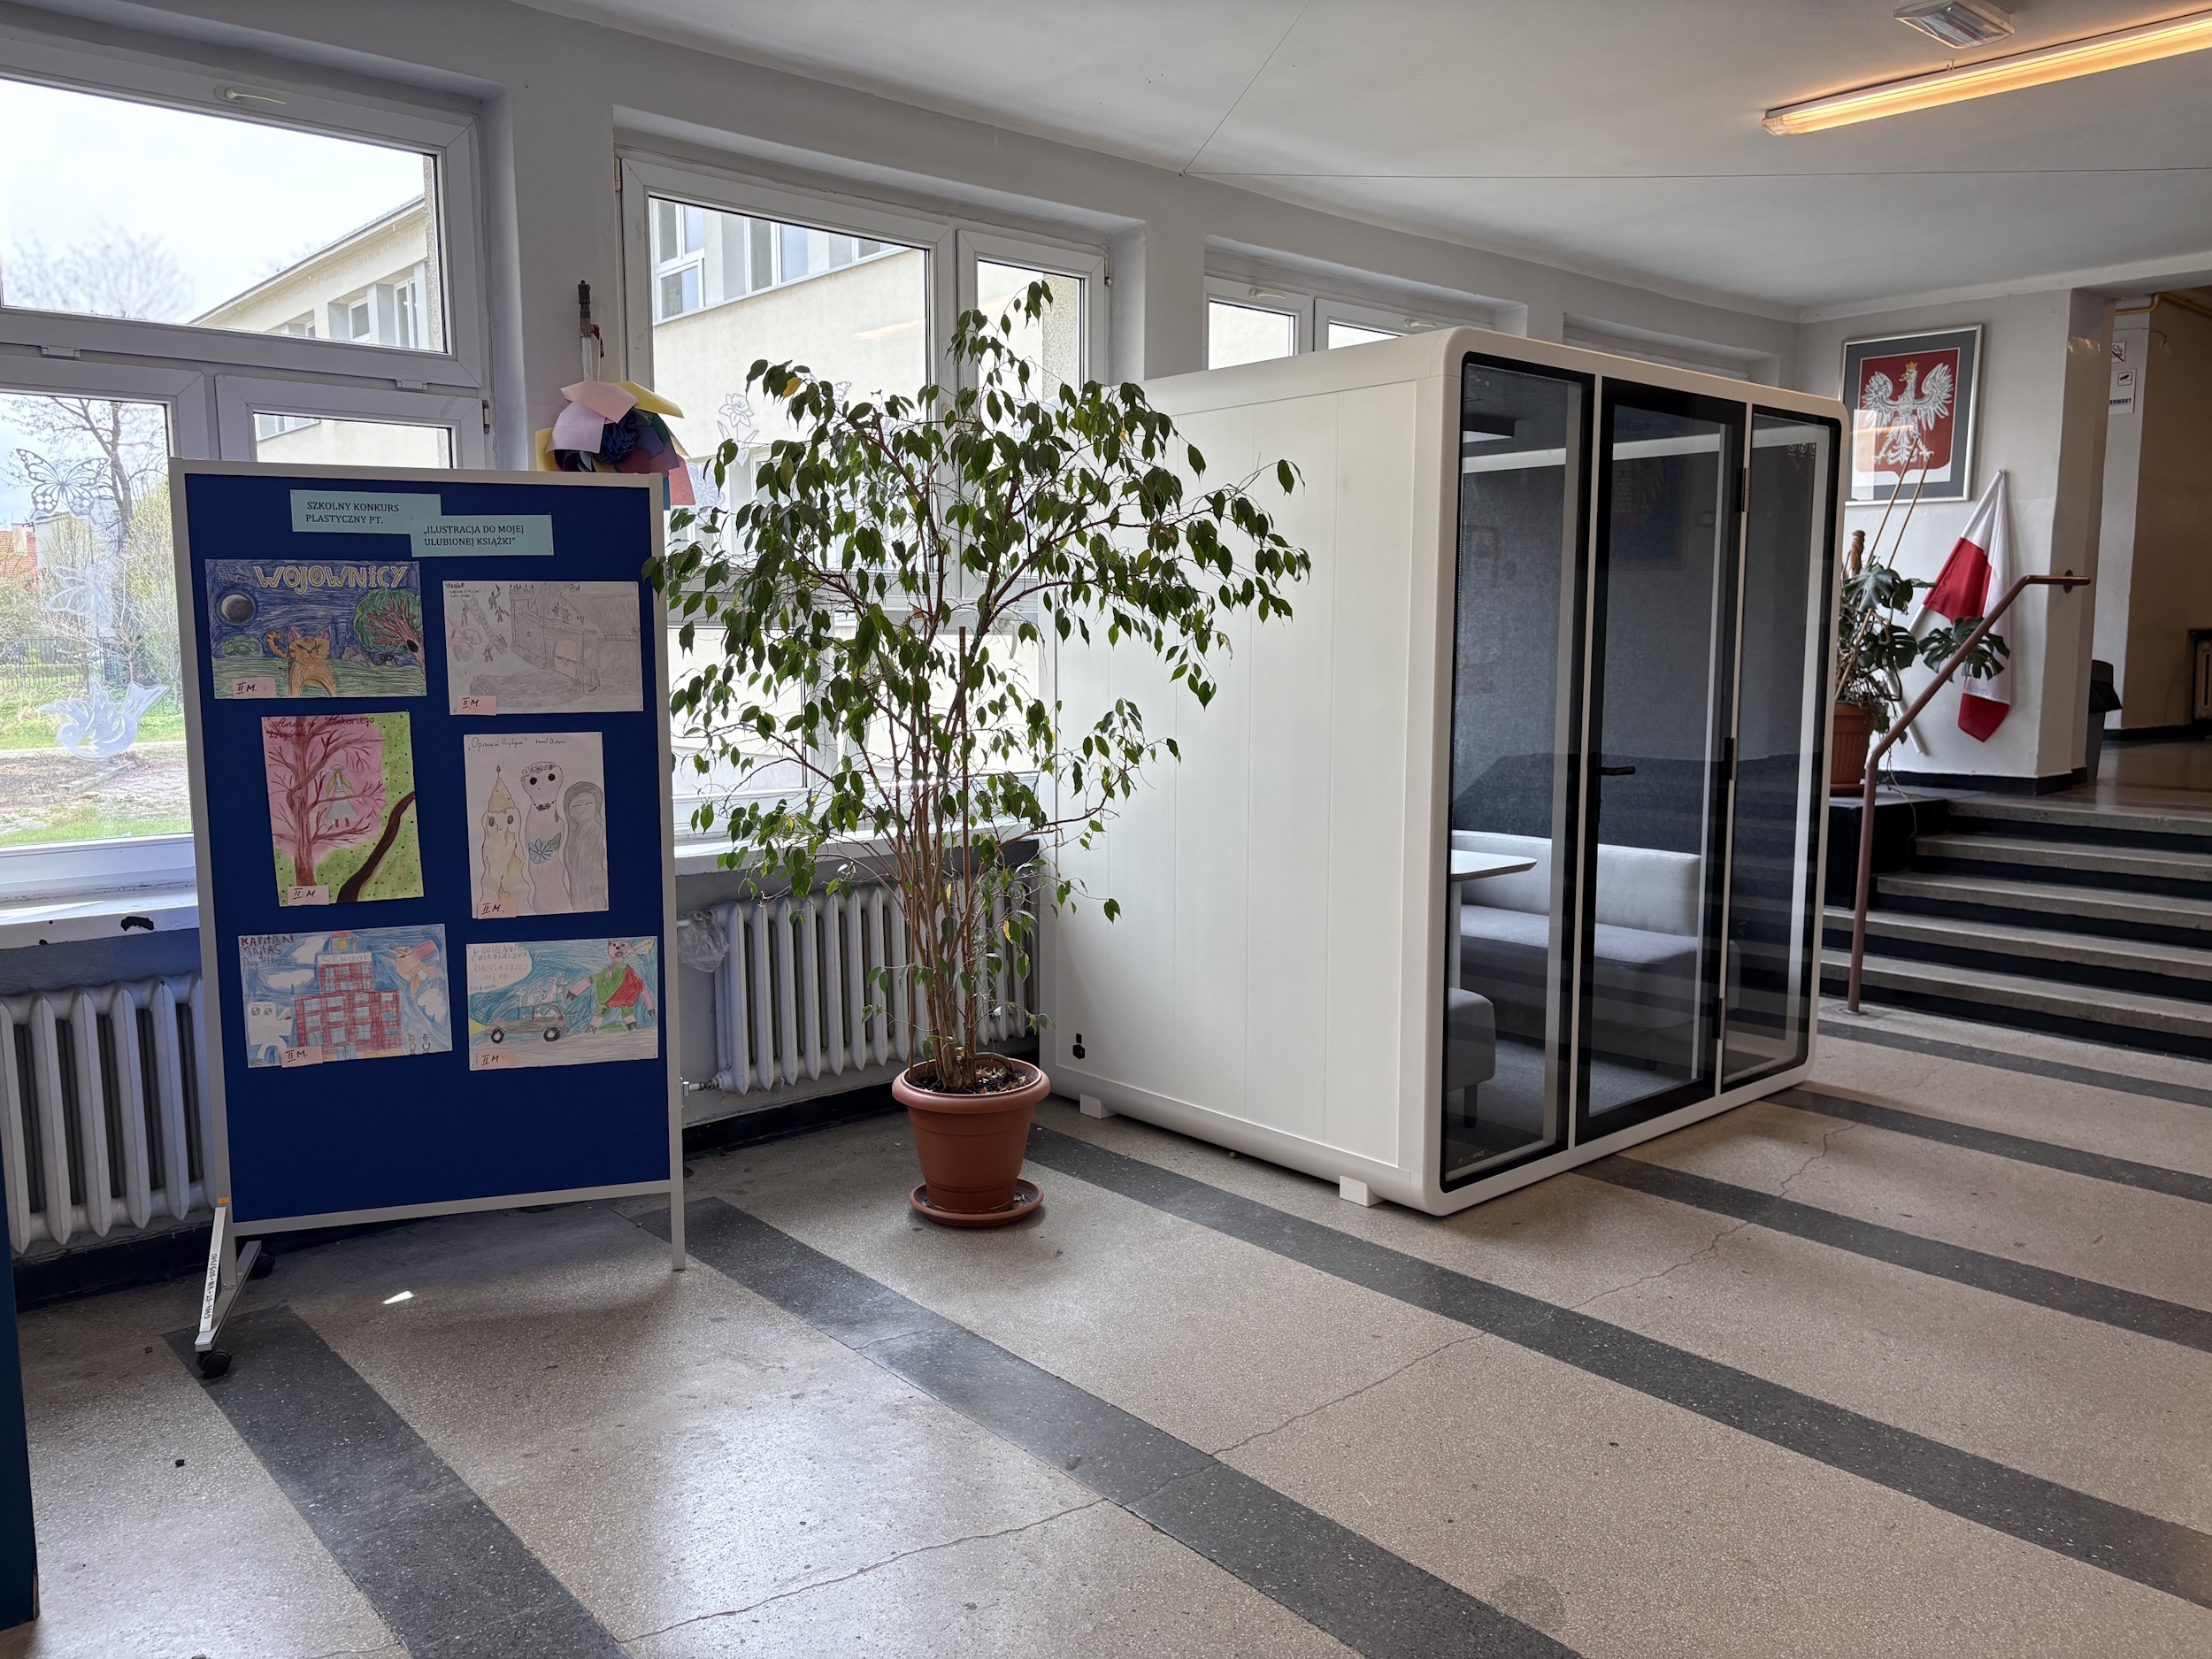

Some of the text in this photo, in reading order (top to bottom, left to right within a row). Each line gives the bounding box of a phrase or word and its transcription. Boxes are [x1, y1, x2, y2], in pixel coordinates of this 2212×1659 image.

[307, 501, 399, 512] SZKOLNY KONKURS
[306, 514, 383, 525] PLASTYCZNY PT.
[423, 525, 480, 534] „ILUSTRACJA
[498, 525, 524, 534] MOJEJ
[424, 538, 474, 547] ULUBIONEJ
